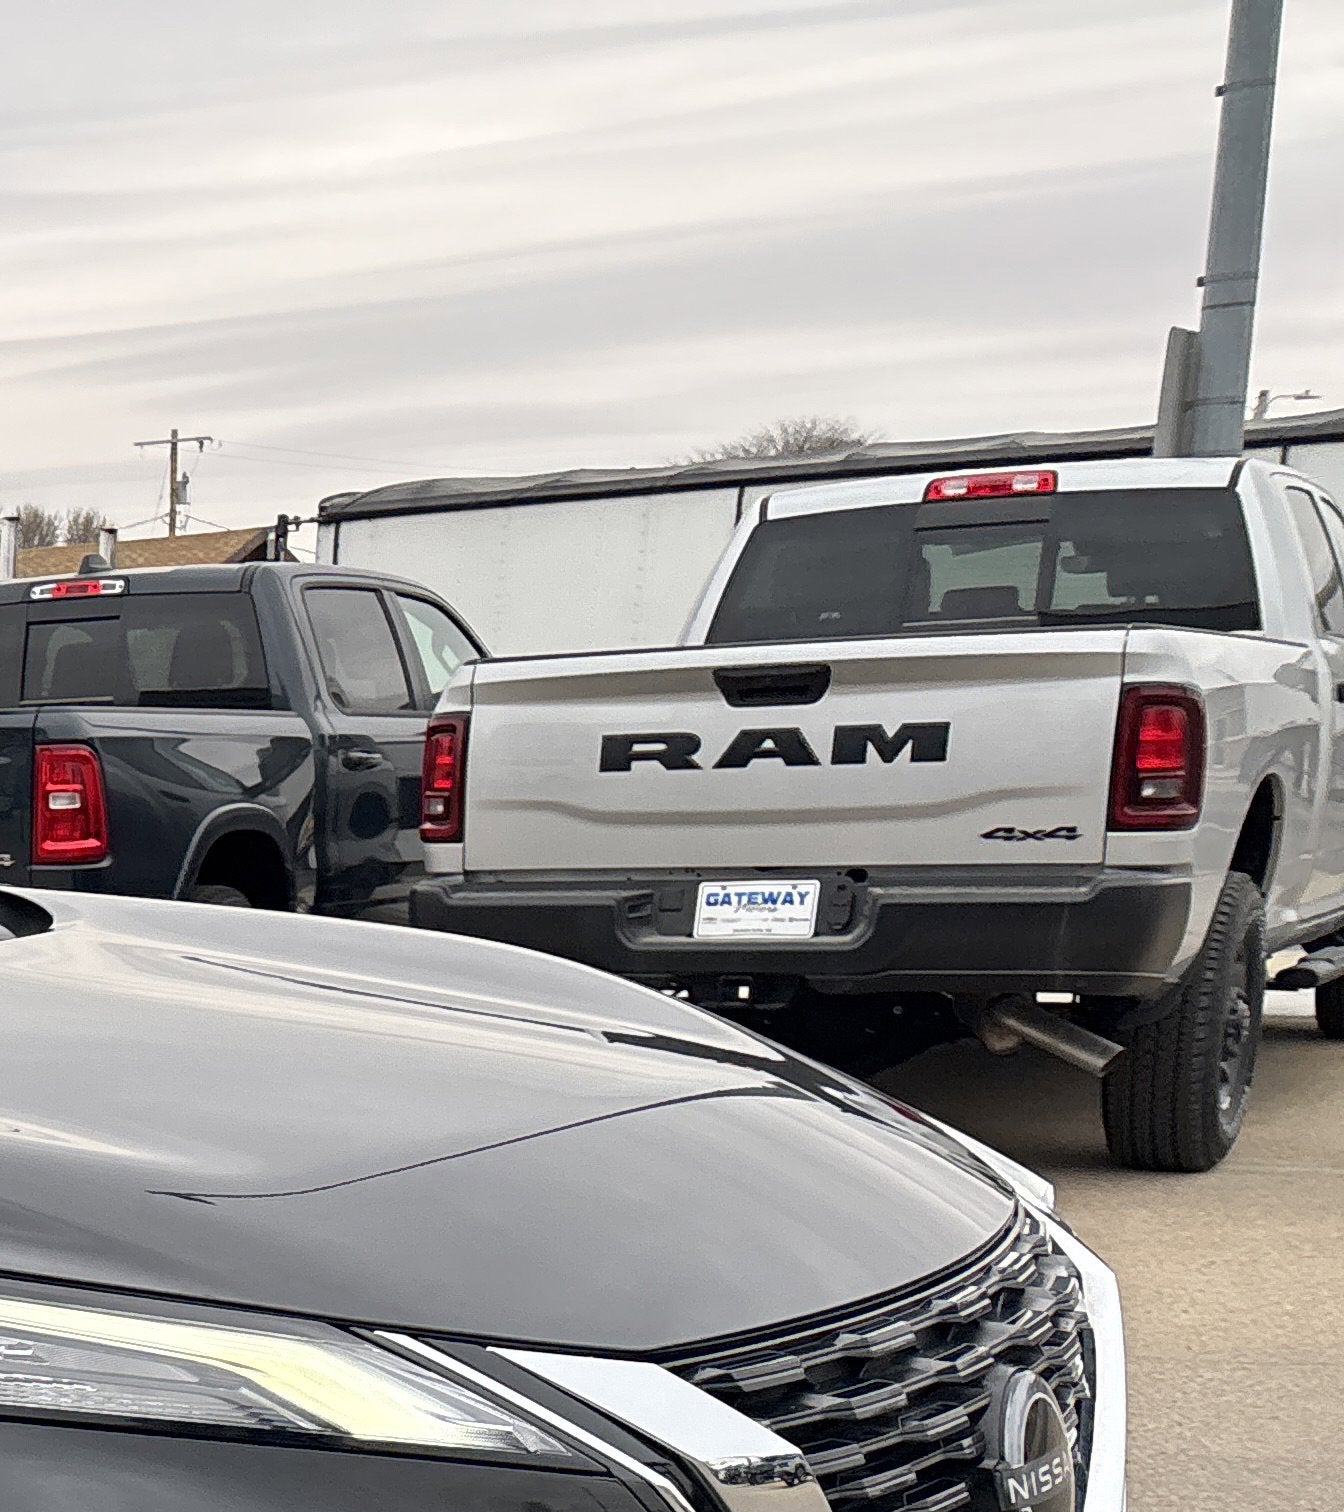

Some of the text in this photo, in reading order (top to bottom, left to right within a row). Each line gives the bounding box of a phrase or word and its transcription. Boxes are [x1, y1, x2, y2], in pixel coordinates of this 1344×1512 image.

[599, 722, 951, 773] RAM
[980, 826, 1083, 842] 4x4
[705, 891, 810, 906] GATEWAY
